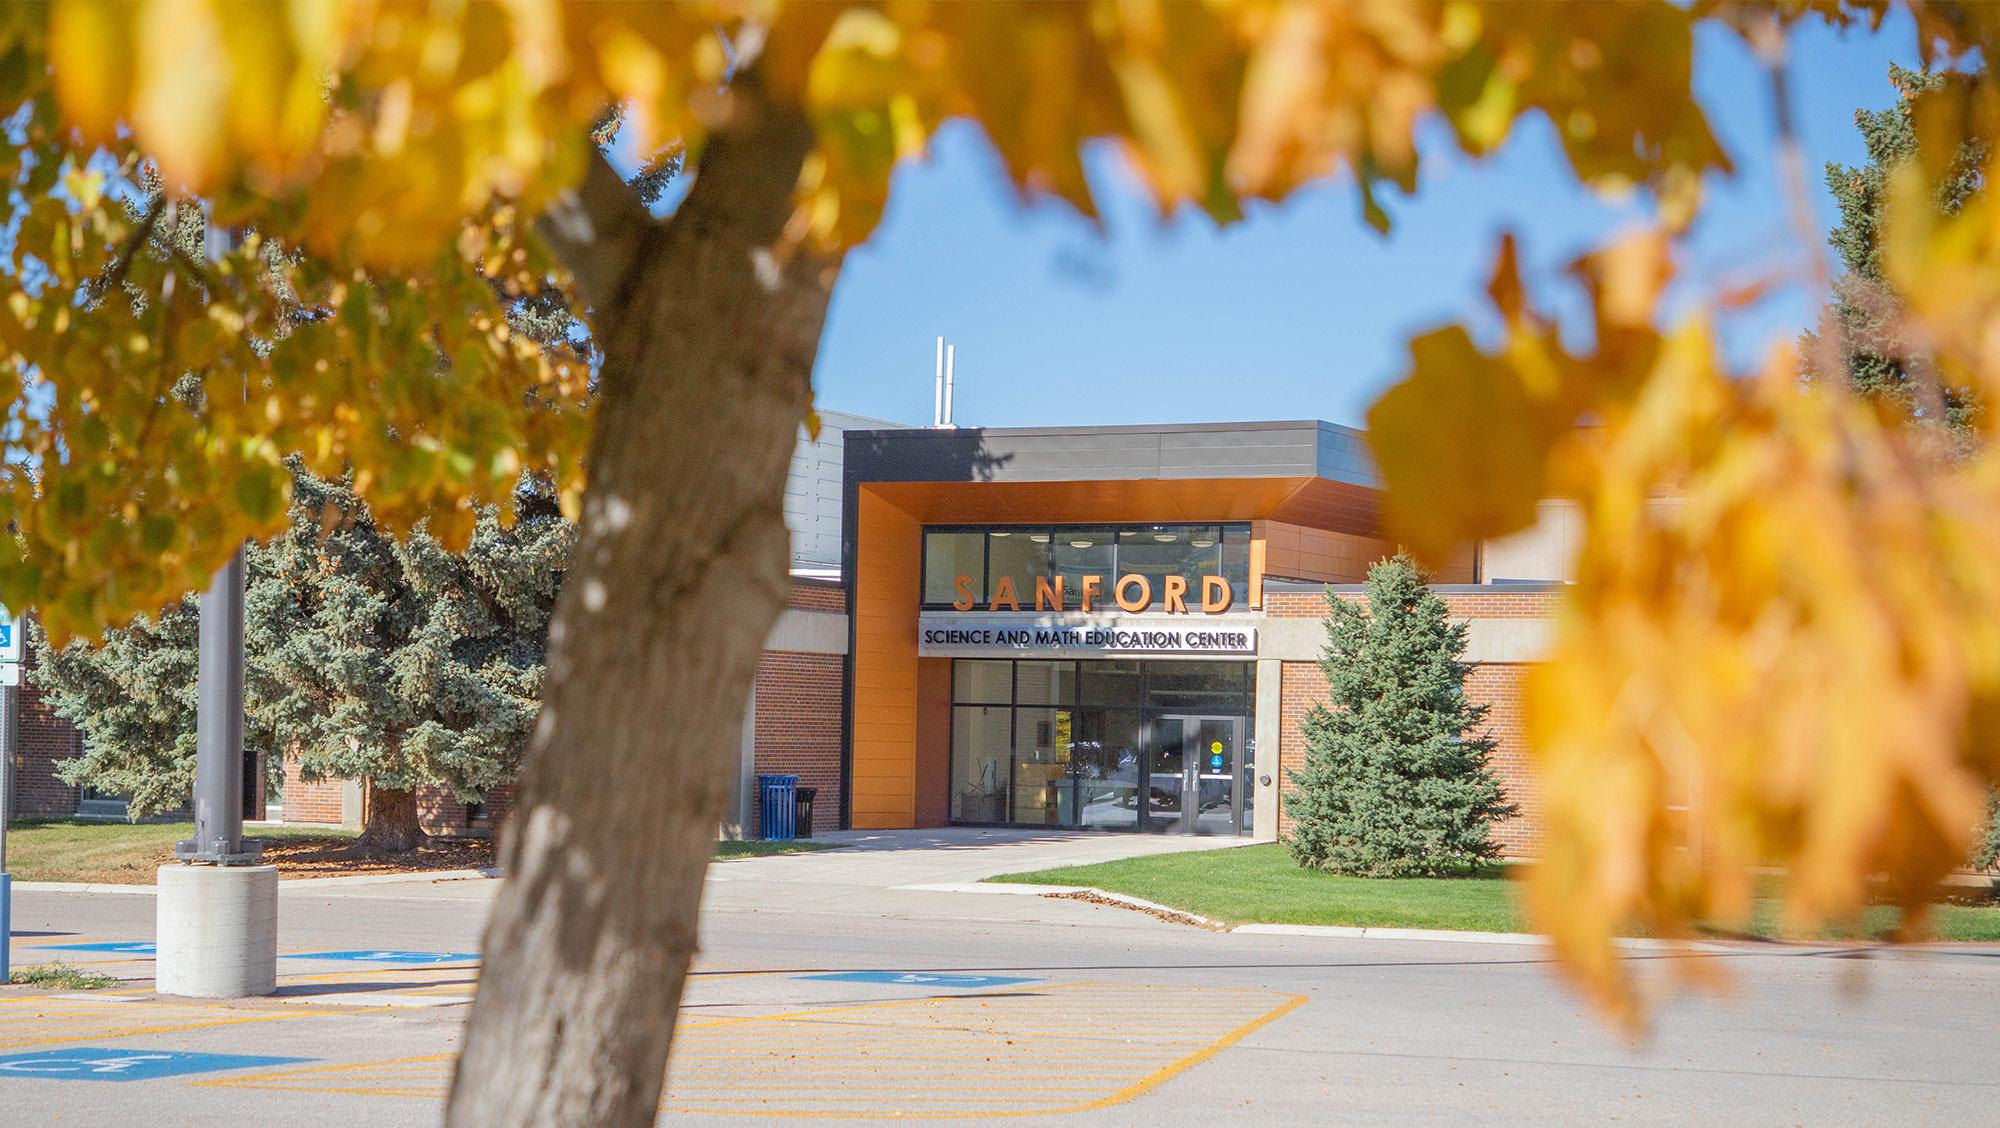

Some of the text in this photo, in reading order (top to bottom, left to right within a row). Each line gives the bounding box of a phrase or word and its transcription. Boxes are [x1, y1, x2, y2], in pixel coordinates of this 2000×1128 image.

[953, 574, 1232, 612] SANFORD
[925, 629, 1247, 647] SCIENCE AND MATH EDUCATION CENTER
